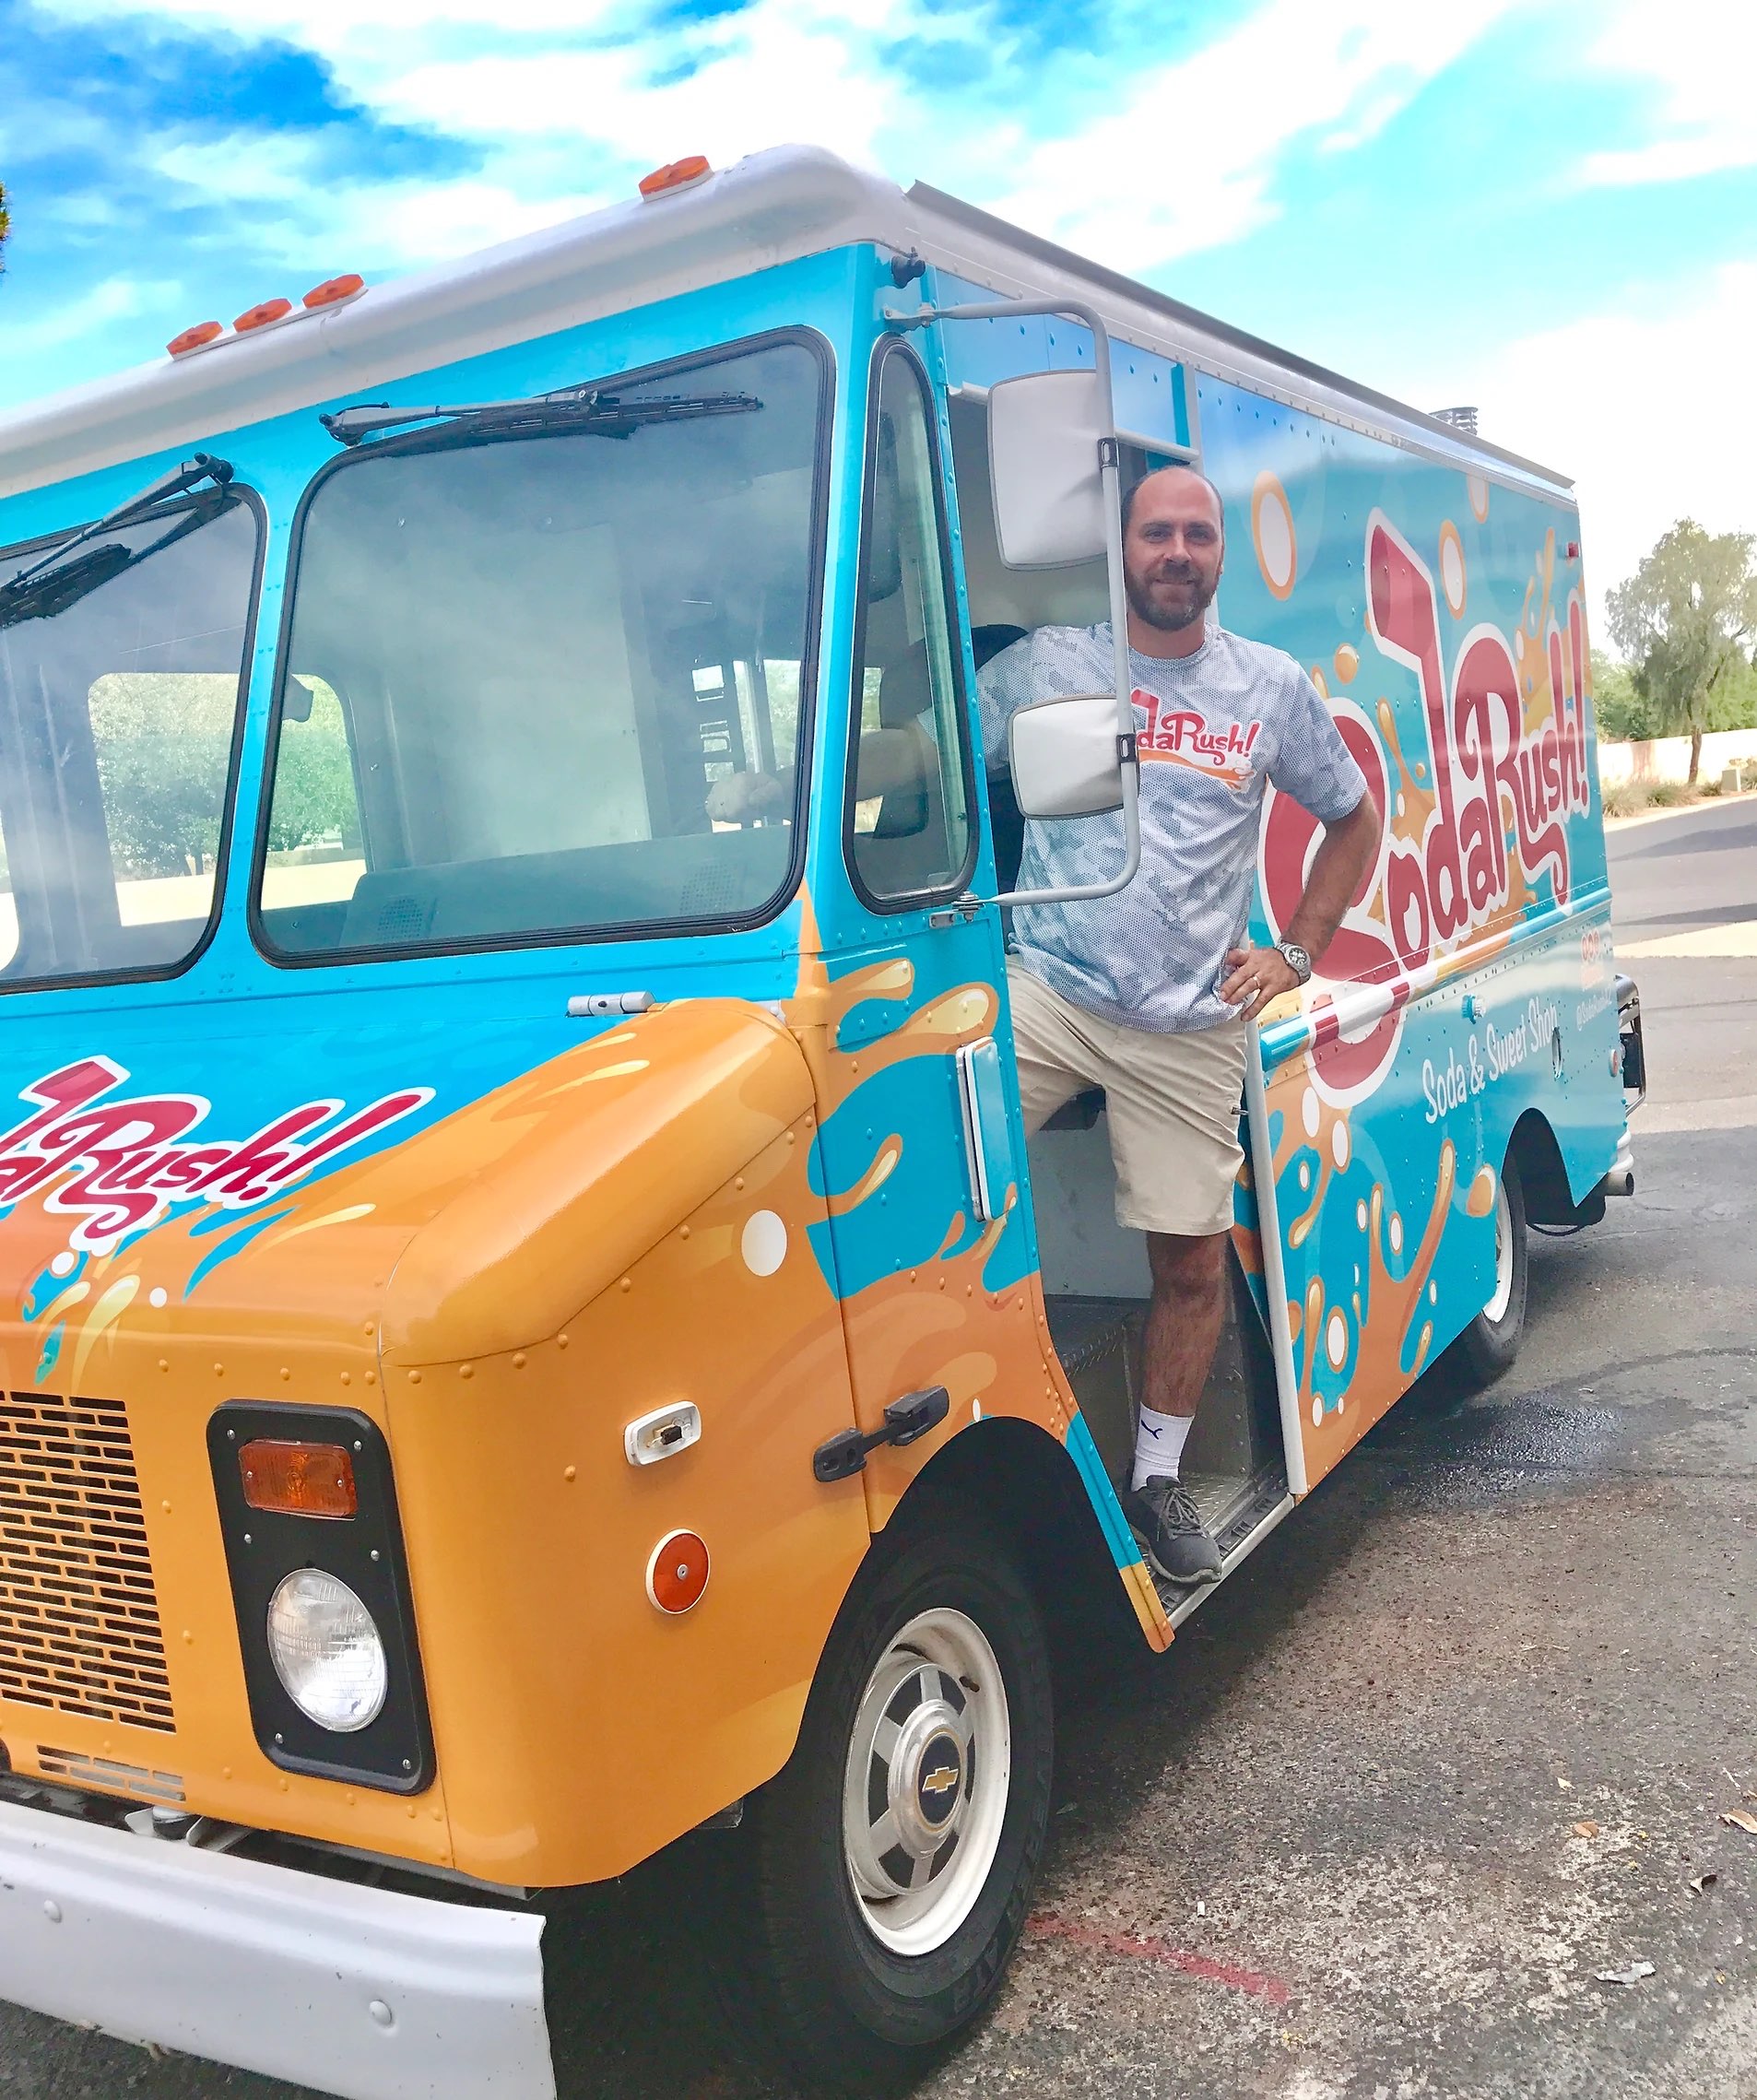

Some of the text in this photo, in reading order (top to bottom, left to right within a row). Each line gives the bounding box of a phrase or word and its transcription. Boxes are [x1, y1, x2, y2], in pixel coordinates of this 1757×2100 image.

[1130, 689, 1260, 765] daRush!
[1261, 516, 1589, 1097] SodaRush!
[1422, 996, 1558, 1124] Soda & Sweet Shop
